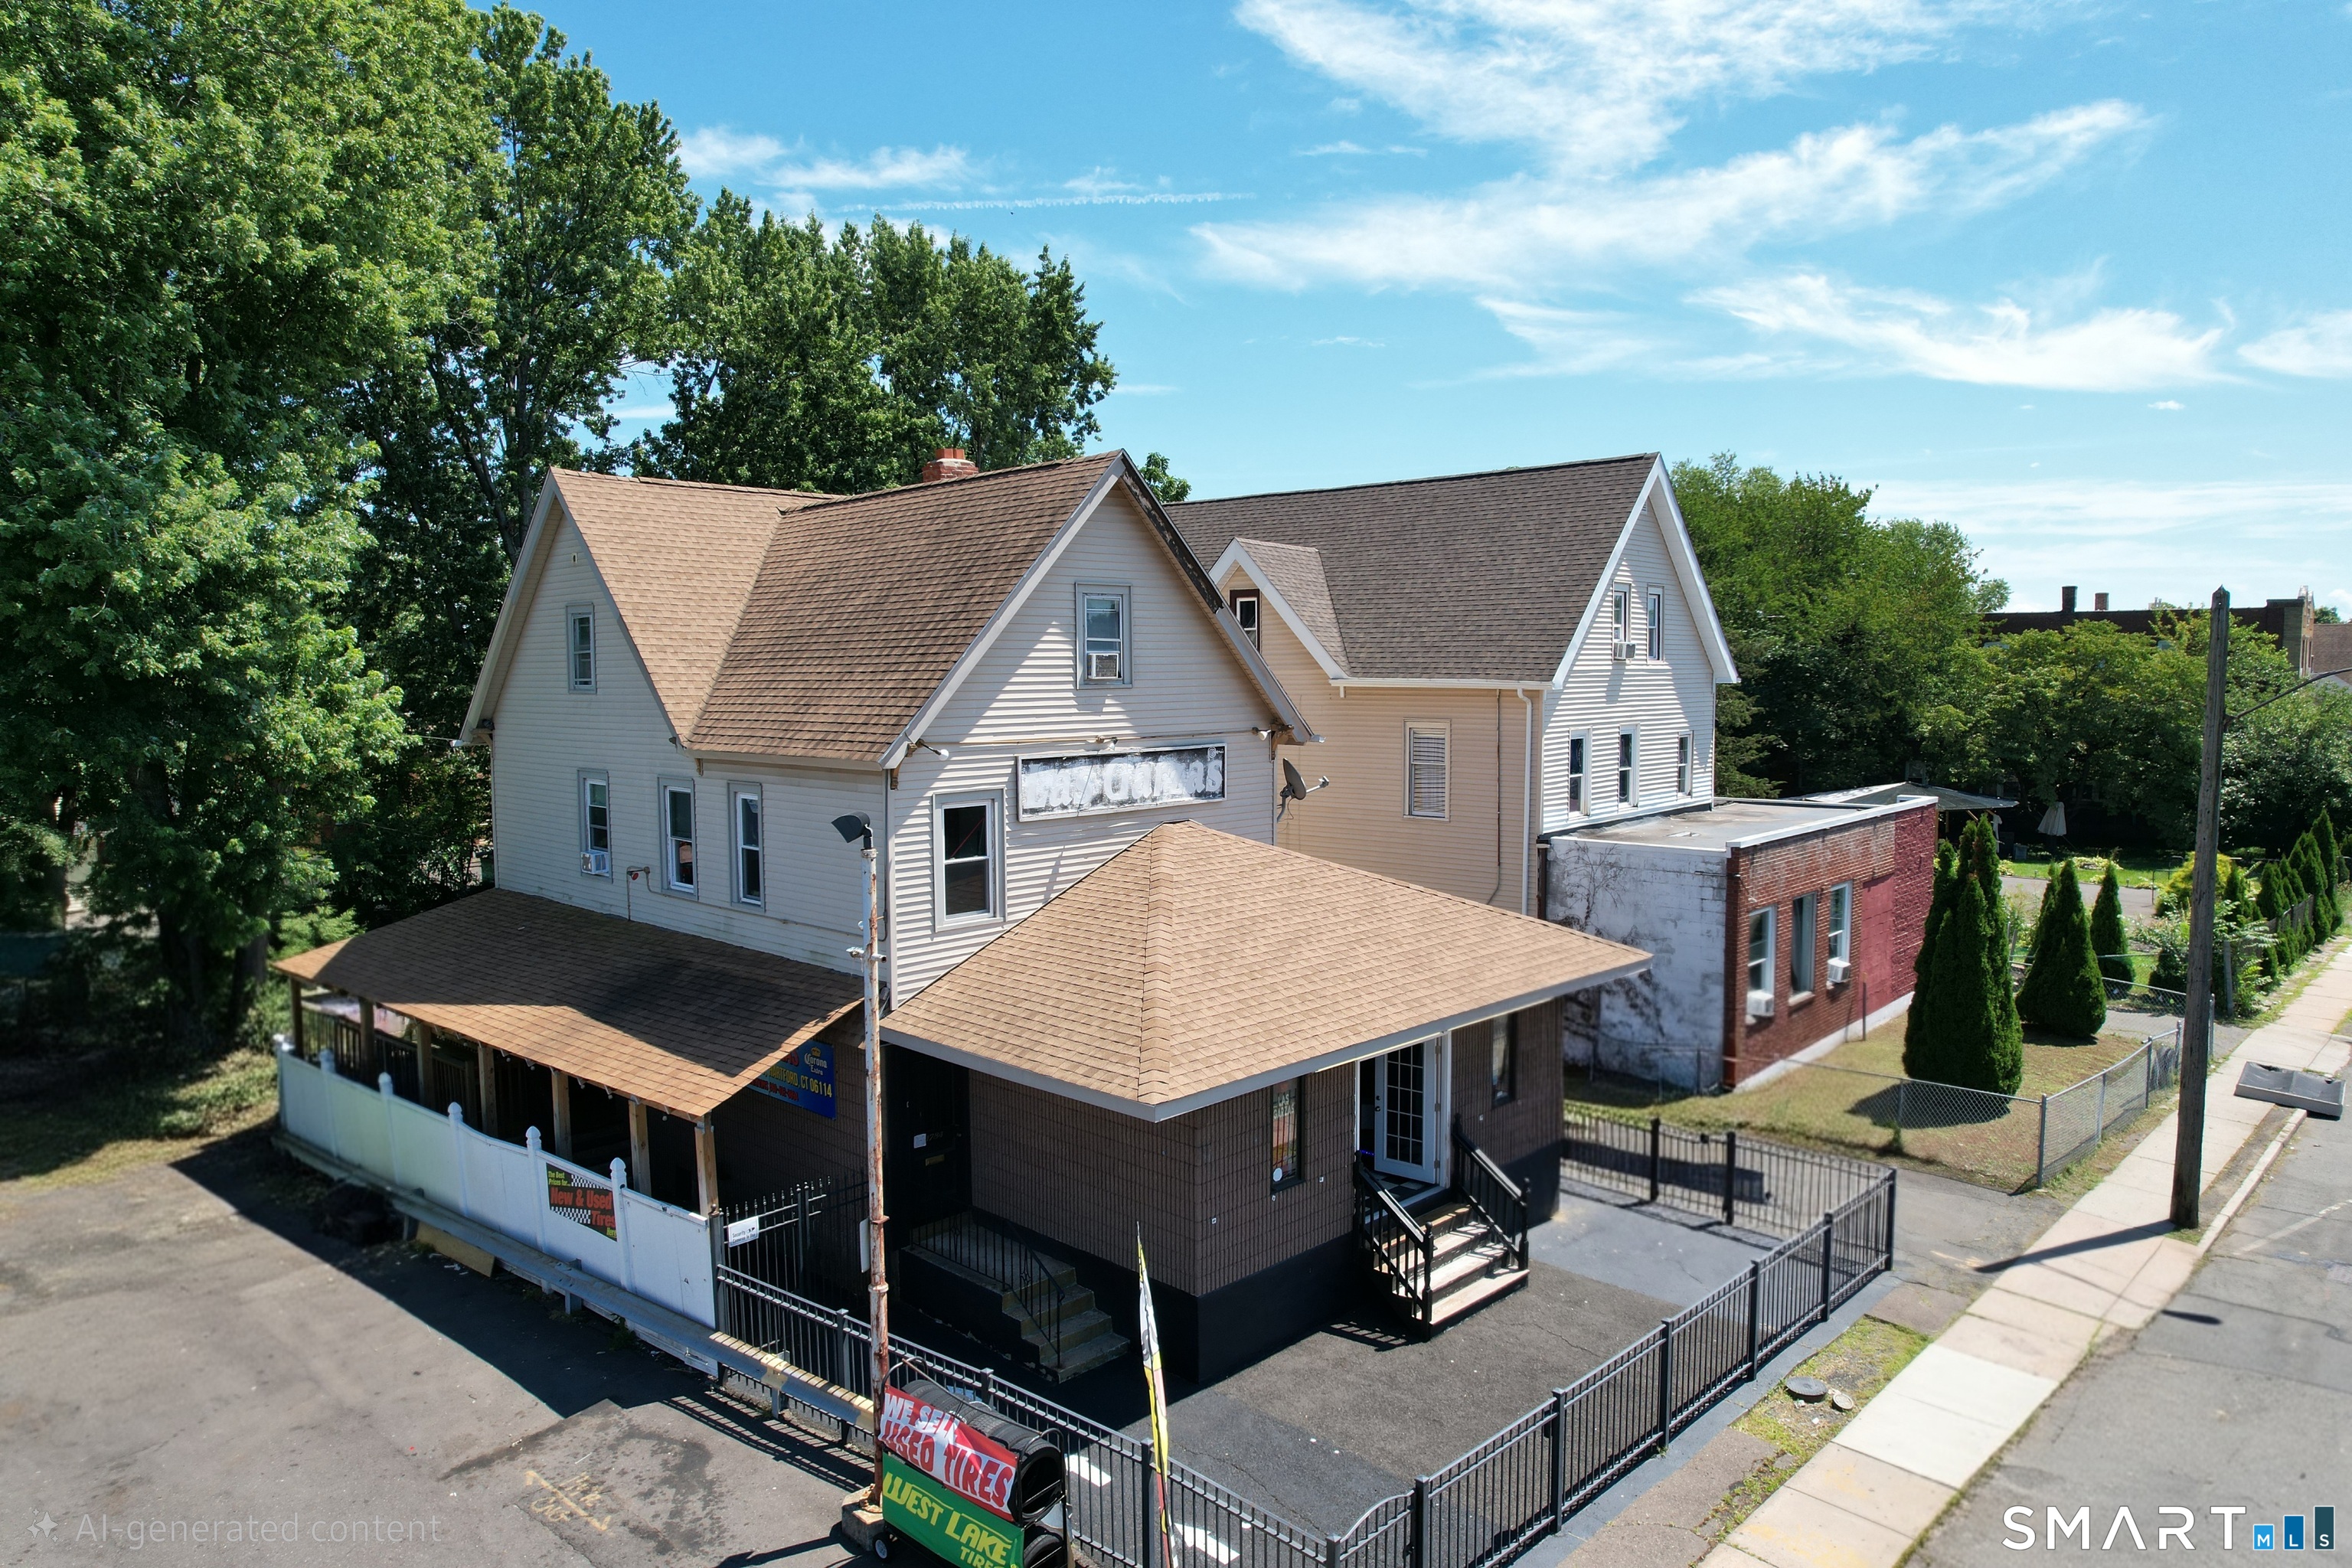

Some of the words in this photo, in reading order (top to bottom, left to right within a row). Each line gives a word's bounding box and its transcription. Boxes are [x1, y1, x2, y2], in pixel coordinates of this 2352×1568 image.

[804, 1053, 828, 1069] Corona
[810, 1064, 823, 1076] Extra
[801, 1075, 808, 1089] CT
[809, 1078, 832, 1098] 06114
[1278, 1093, 1290, 1106] LAS
[1272, 1102, 1295, 1120] GARZAS
[550, 1187, 573, 1206] New
[575, 1189, 583, 1207] &
[586, 1190, 612, 1210] Used
[591, 1210, 616, 1228] Tires
[884, 1393, 914, 1422] WE
[915, 1406, 961, 1441] SELL
[882, 1420, 935, 1472] USED
[943, 1444, 1013, 1508] TIRES
[882, 1472, 944, 1526] WEST
[945, 1510, 1011, 1565] LAKE
[960, 1546, 1004, 1568] TIRE
